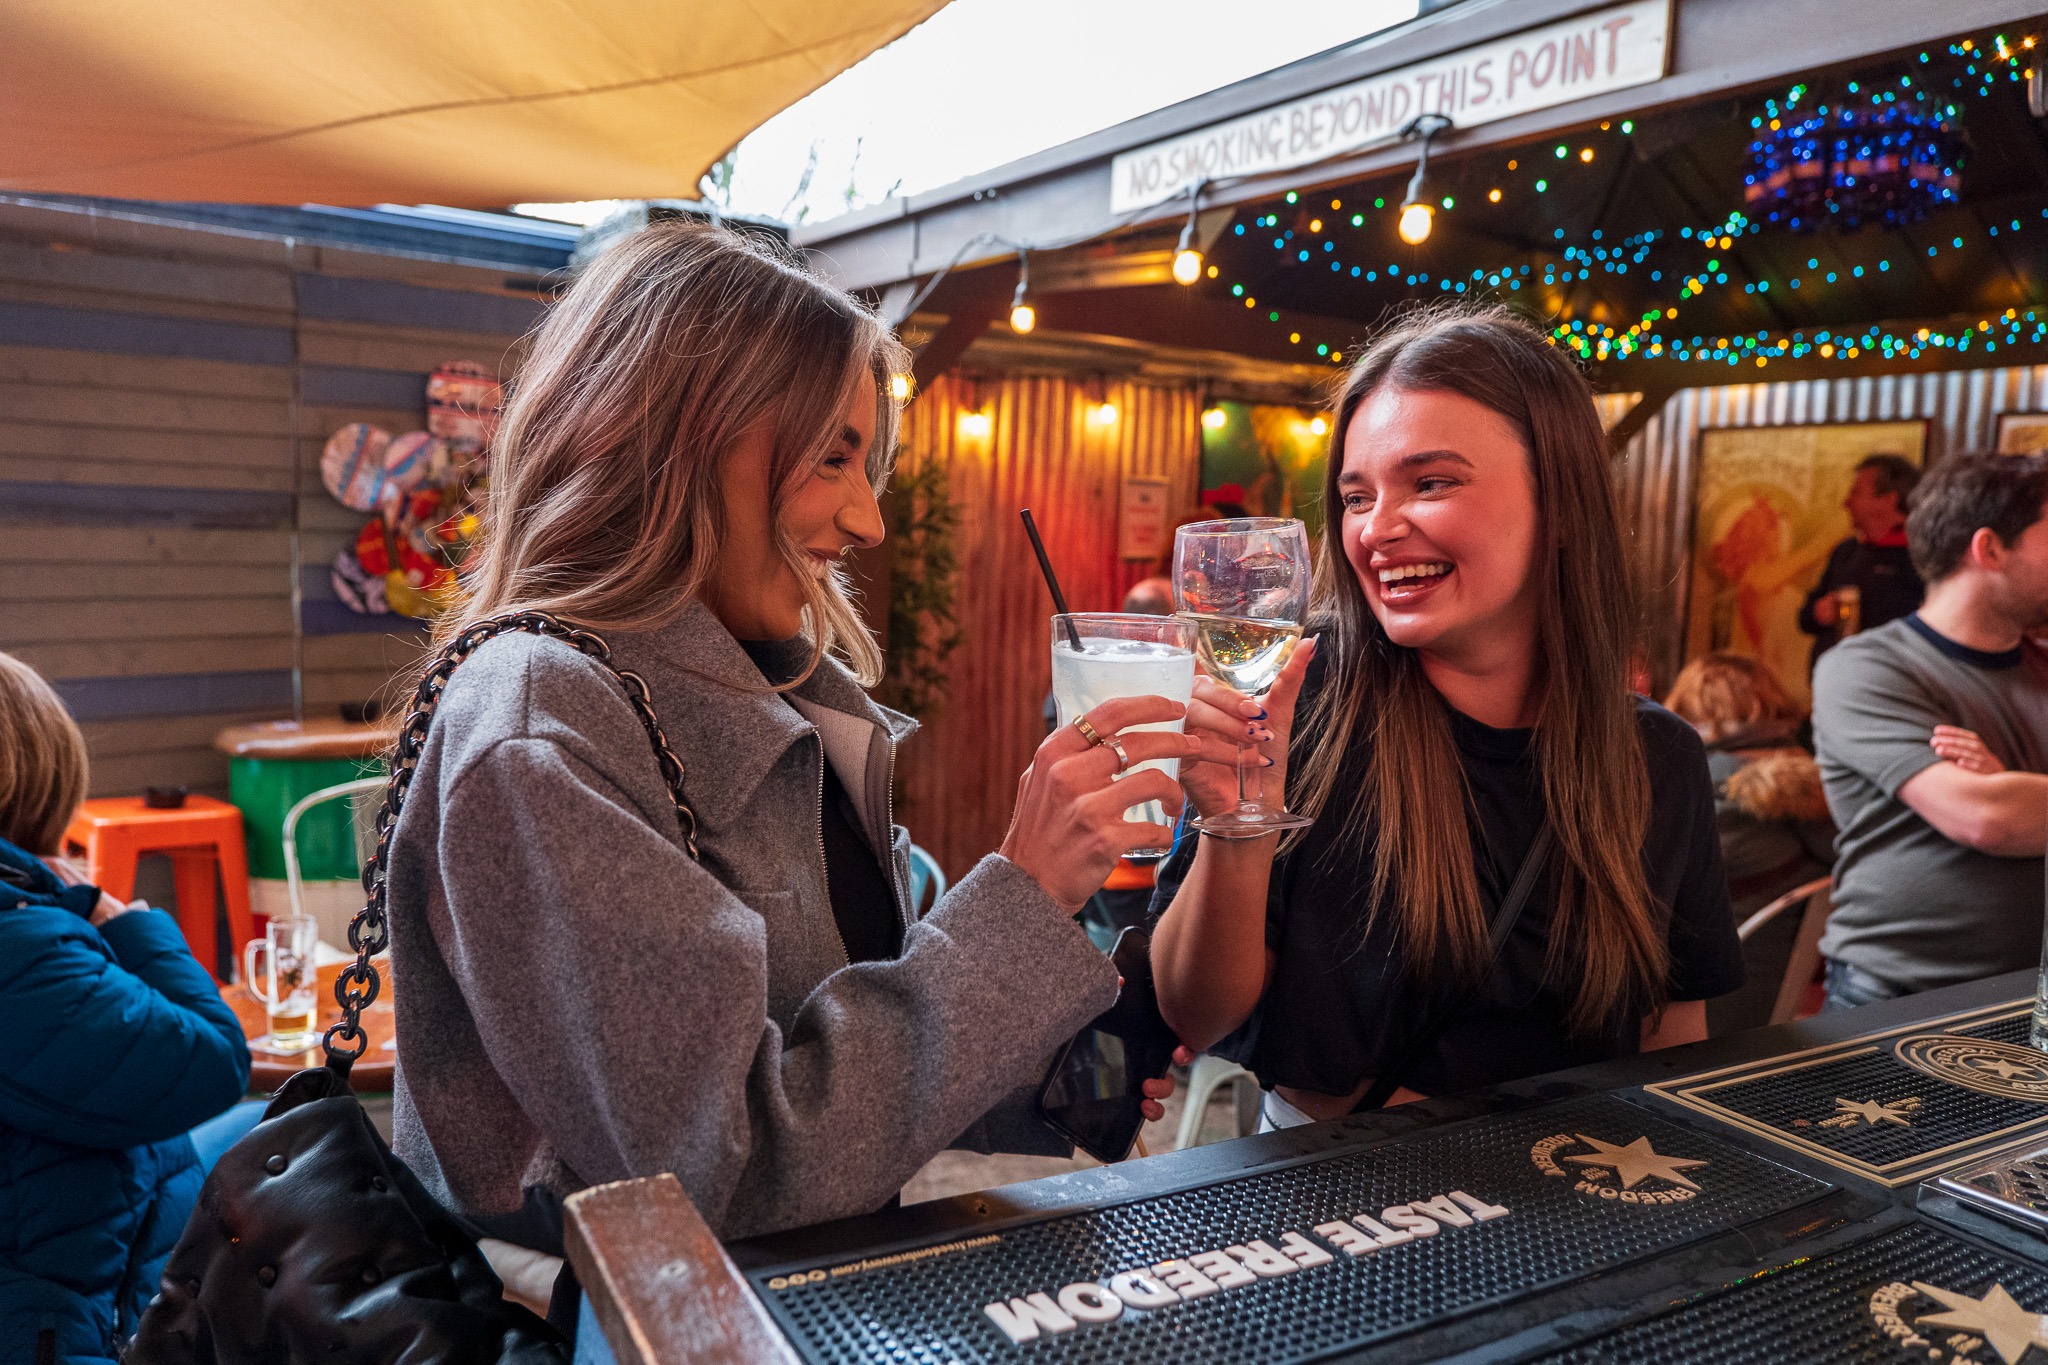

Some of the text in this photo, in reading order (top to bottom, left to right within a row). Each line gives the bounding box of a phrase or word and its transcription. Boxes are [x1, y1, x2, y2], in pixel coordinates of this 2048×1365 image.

[1129, 15, 1633, 198] NO SMOKING BEYOND THIS POINT
[1530, 1133, 1577, 1177] BREWERY
[1573, 1180, 1697, 1205] FREEDOM
[983, 1190, 1510, 1344] TASTE FREEDOM
